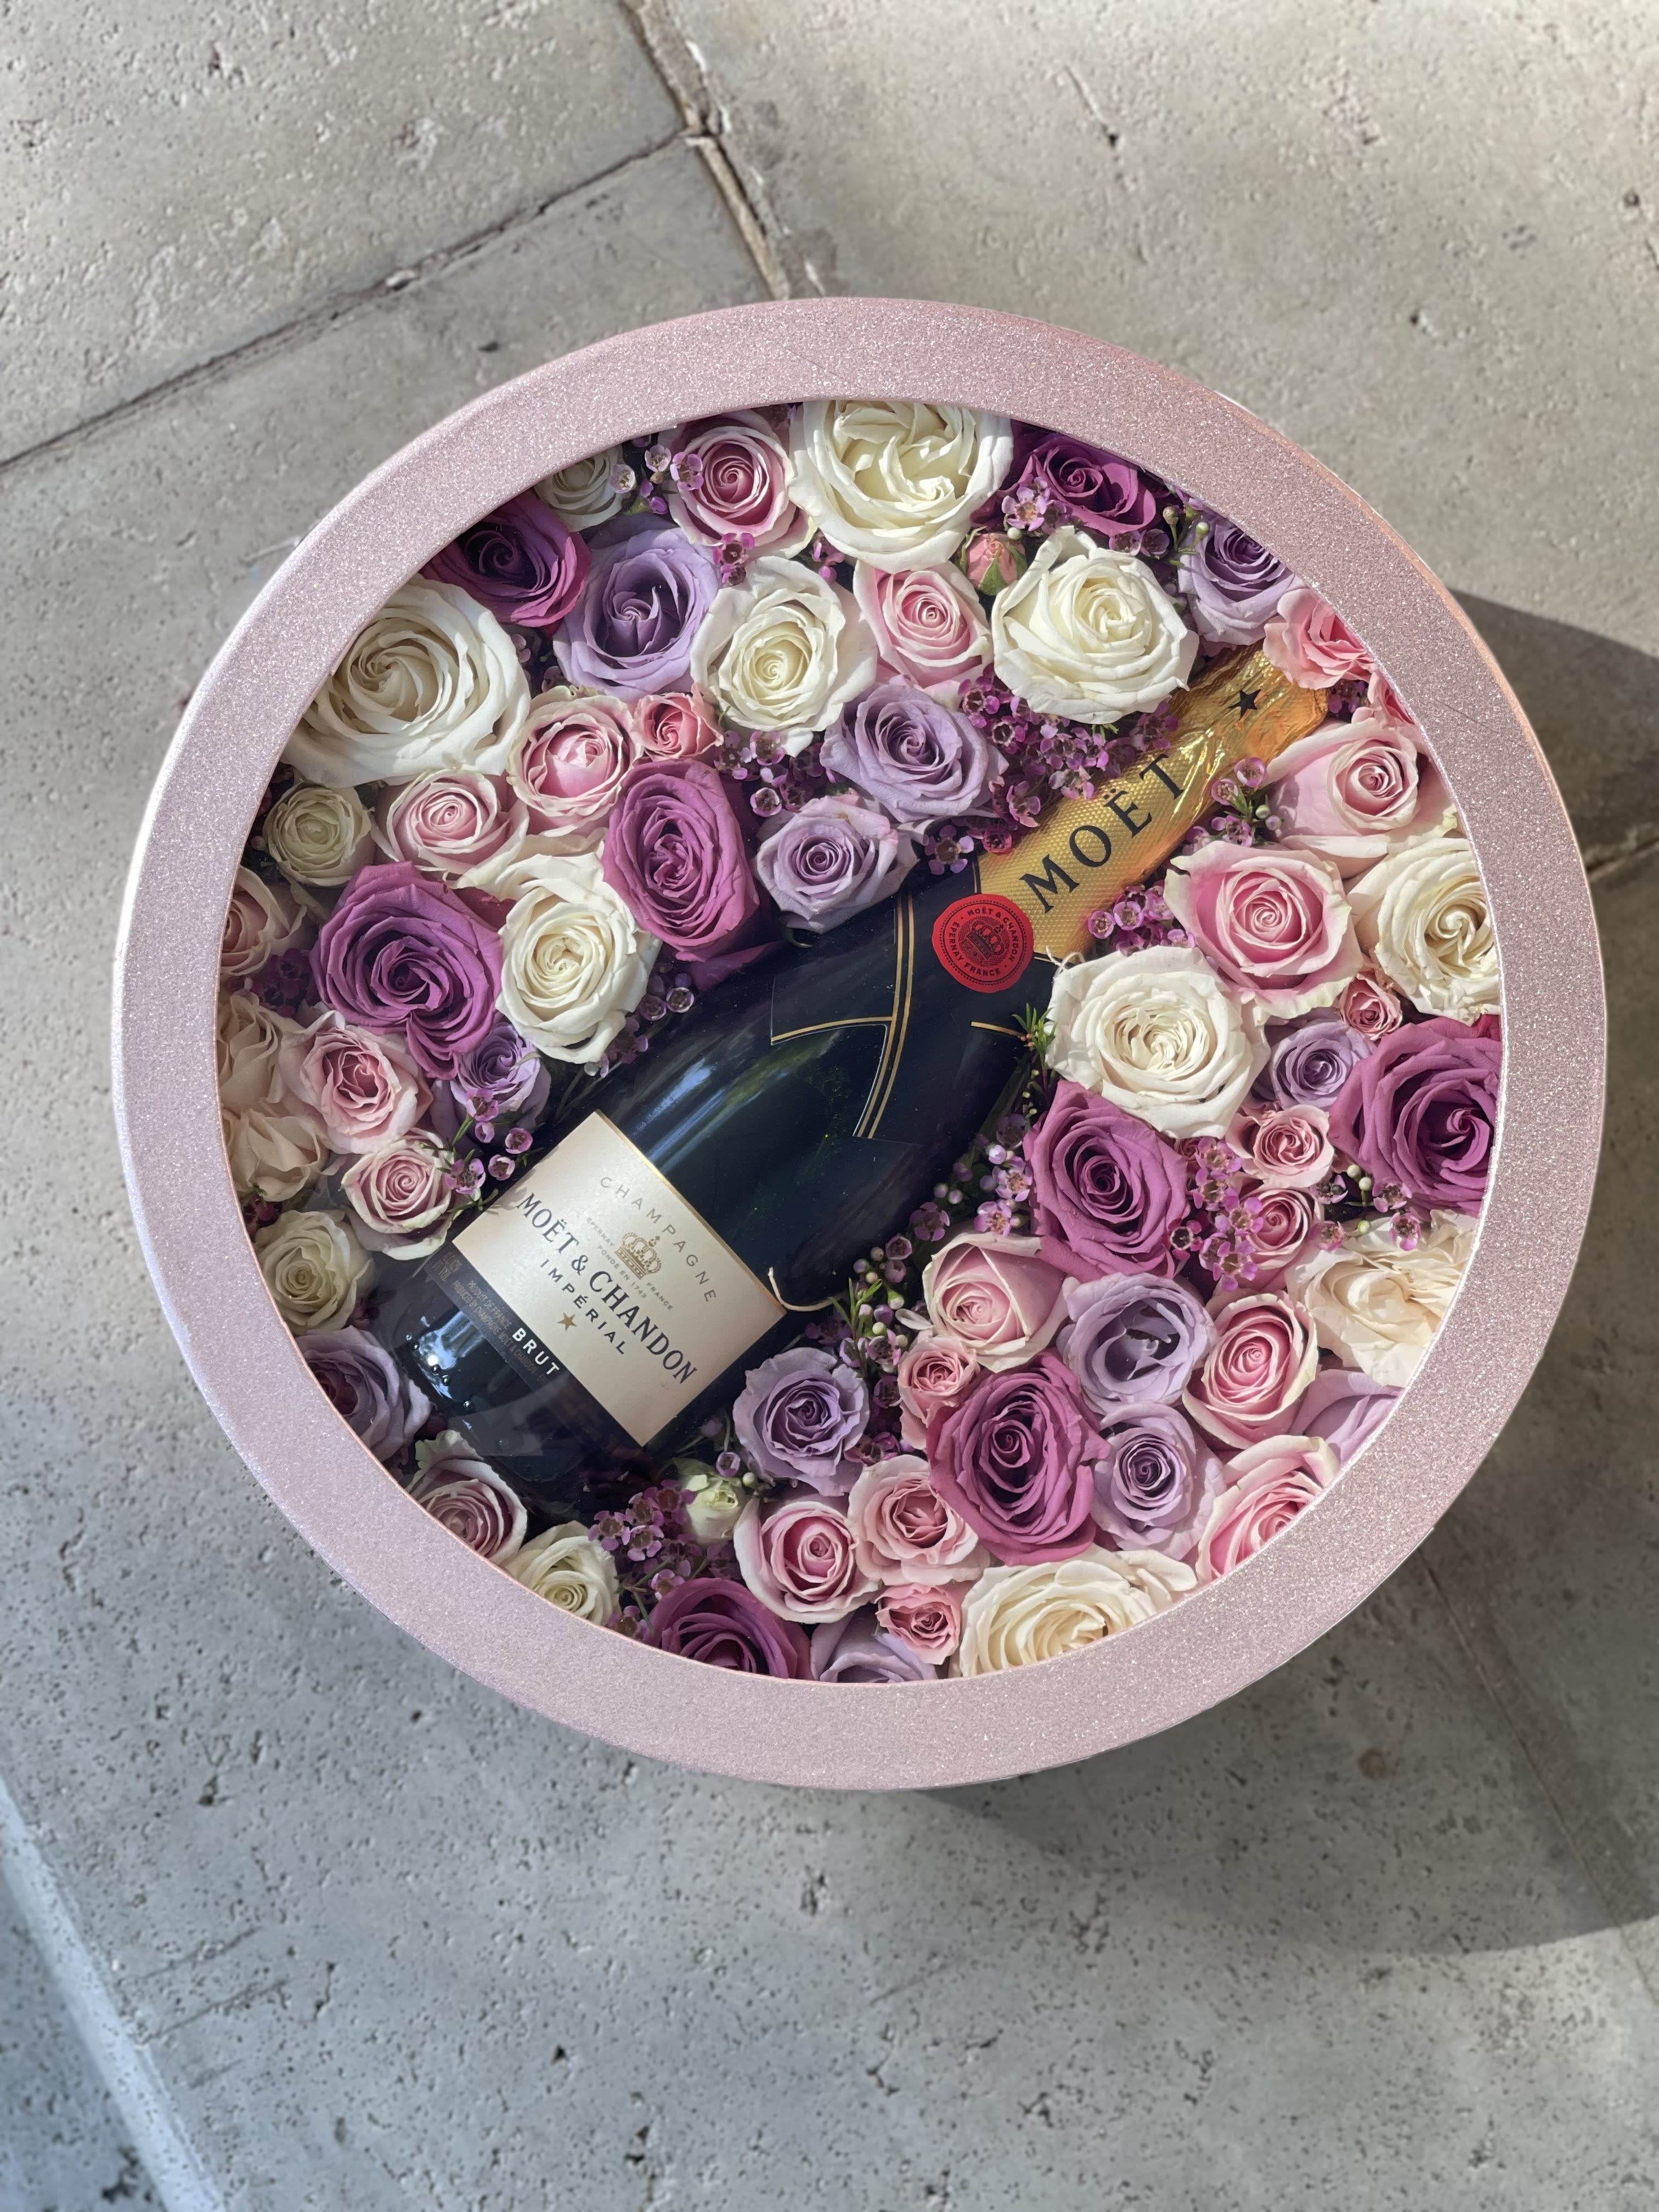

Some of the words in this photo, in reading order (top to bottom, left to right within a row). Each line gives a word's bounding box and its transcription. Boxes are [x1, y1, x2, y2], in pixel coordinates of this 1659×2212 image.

[1019, 753, 1185, 914] MOËT
[964, 962, 1001, 977] FRANCE
[967, 906, 993, 917] MOËT
[1003, 917, 1019, 962] CHANDON
[600, 1176, 716, 1302] CHAMPAGNE
[619, 1271, 630, 1281] EN
[516, 1193, 579, 1255] MOËT
[571, 1254, 589, 1276] &
[589, 1271, 697, 1384] CHANDON
[540, 1259, 625, 1355] IMPÉRIAL
[512, 1328, 560, 1375] BRUT
